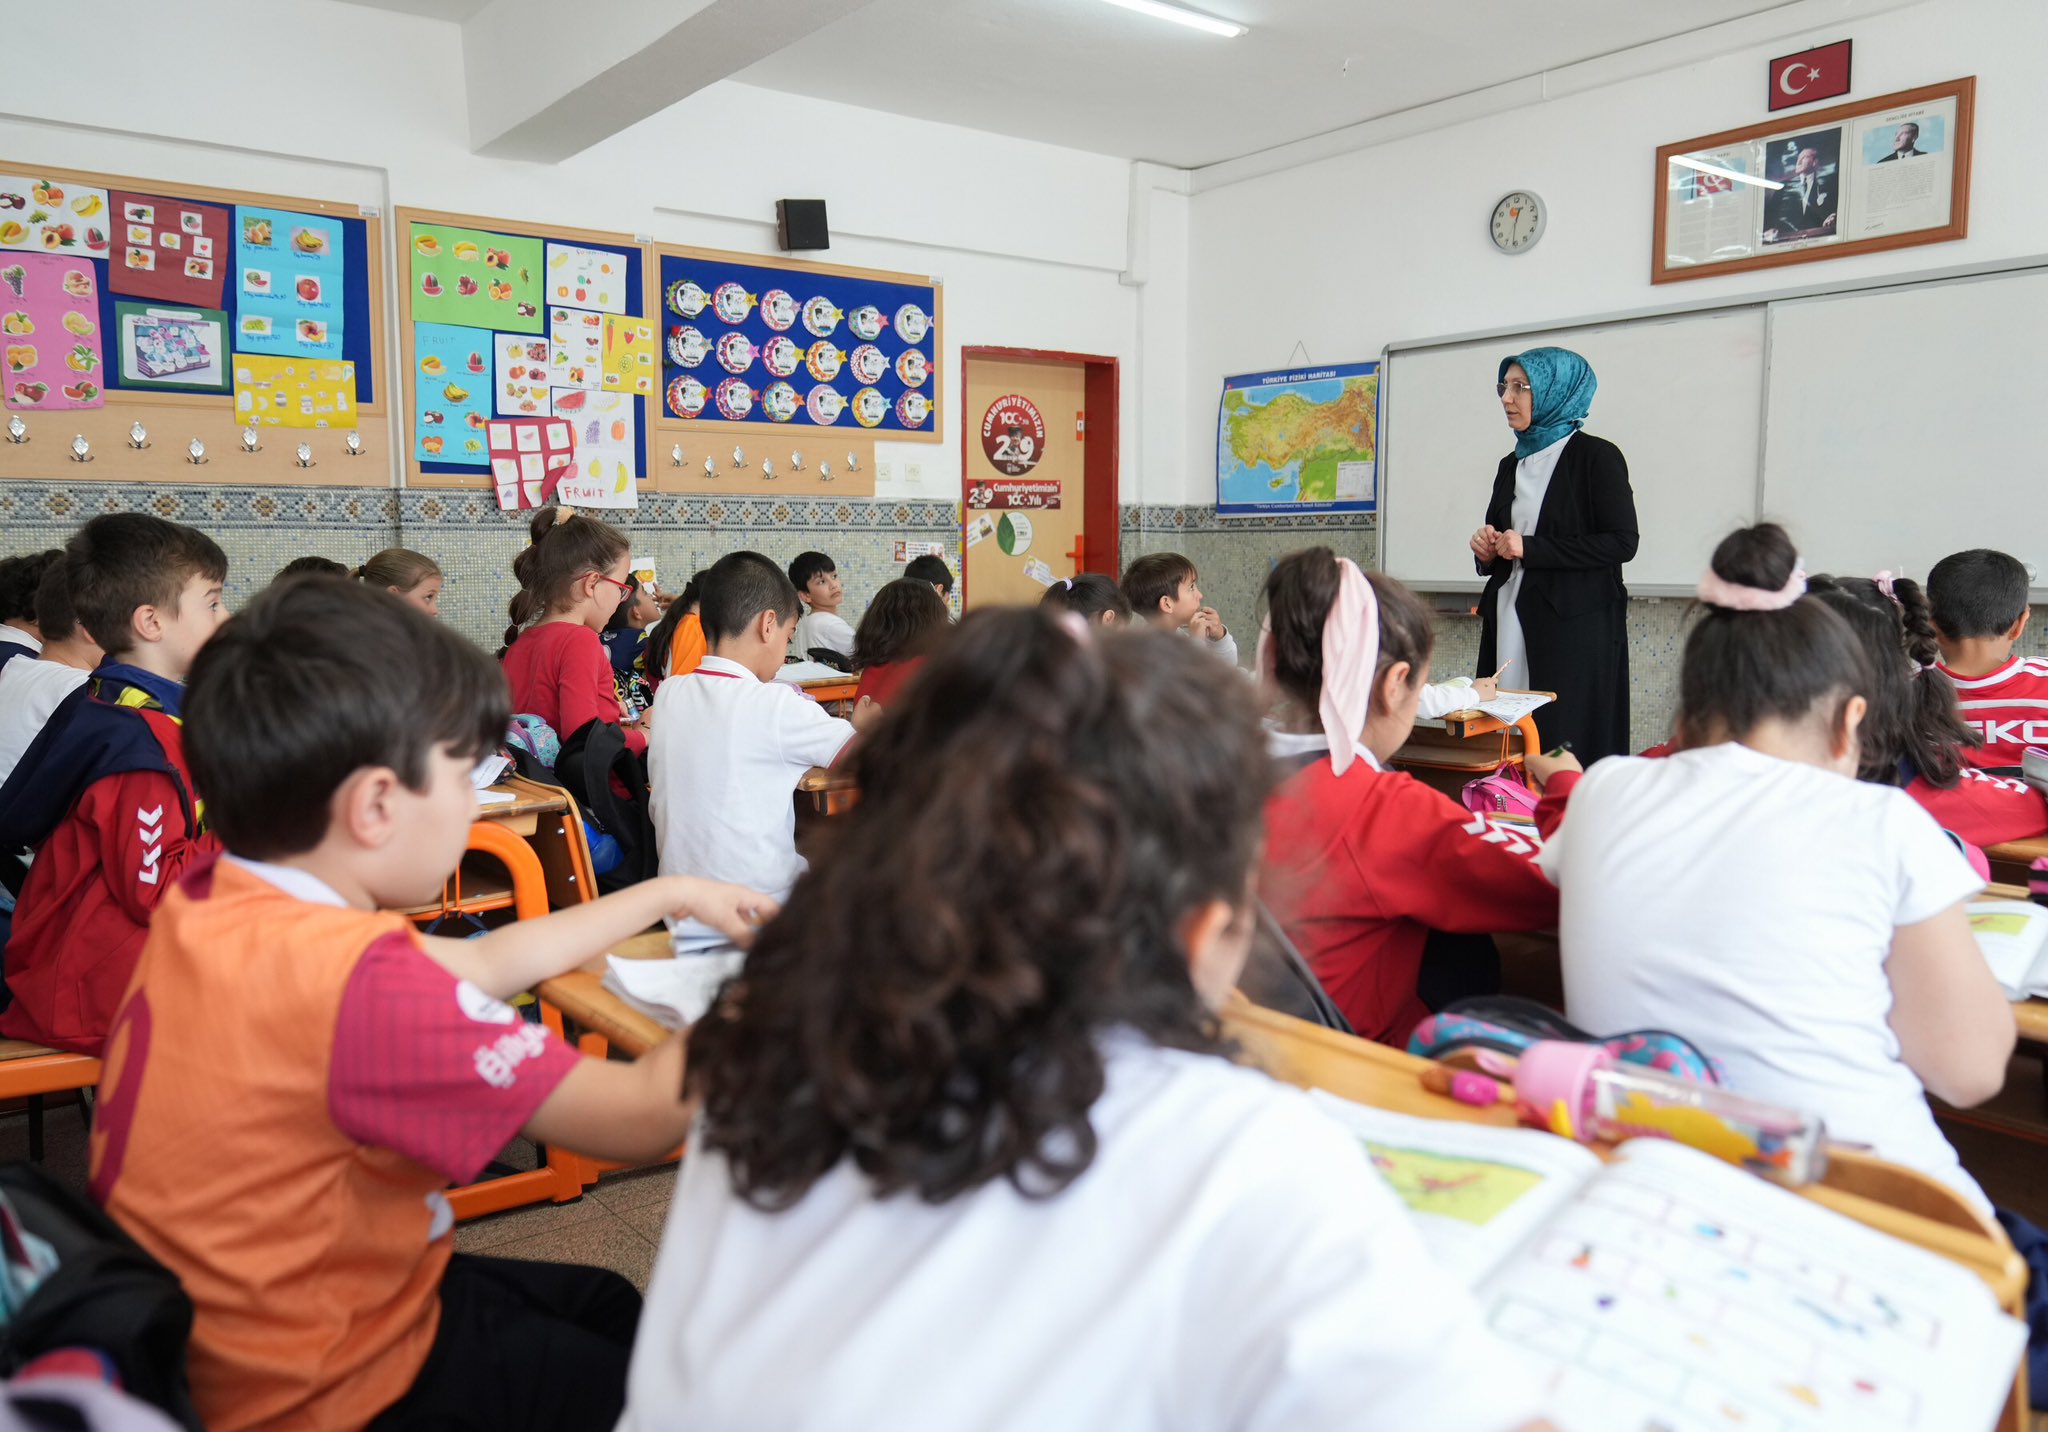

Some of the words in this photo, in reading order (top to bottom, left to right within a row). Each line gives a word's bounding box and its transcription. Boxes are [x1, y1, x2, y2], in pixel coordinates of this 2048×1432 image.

[422, 336, 456, 346] FRUIT
[1262, 376, 1287, 384] TÜRKİYE
[563, 486, 605, 499] FRUIT
[968, 488, 993, 504] 29
